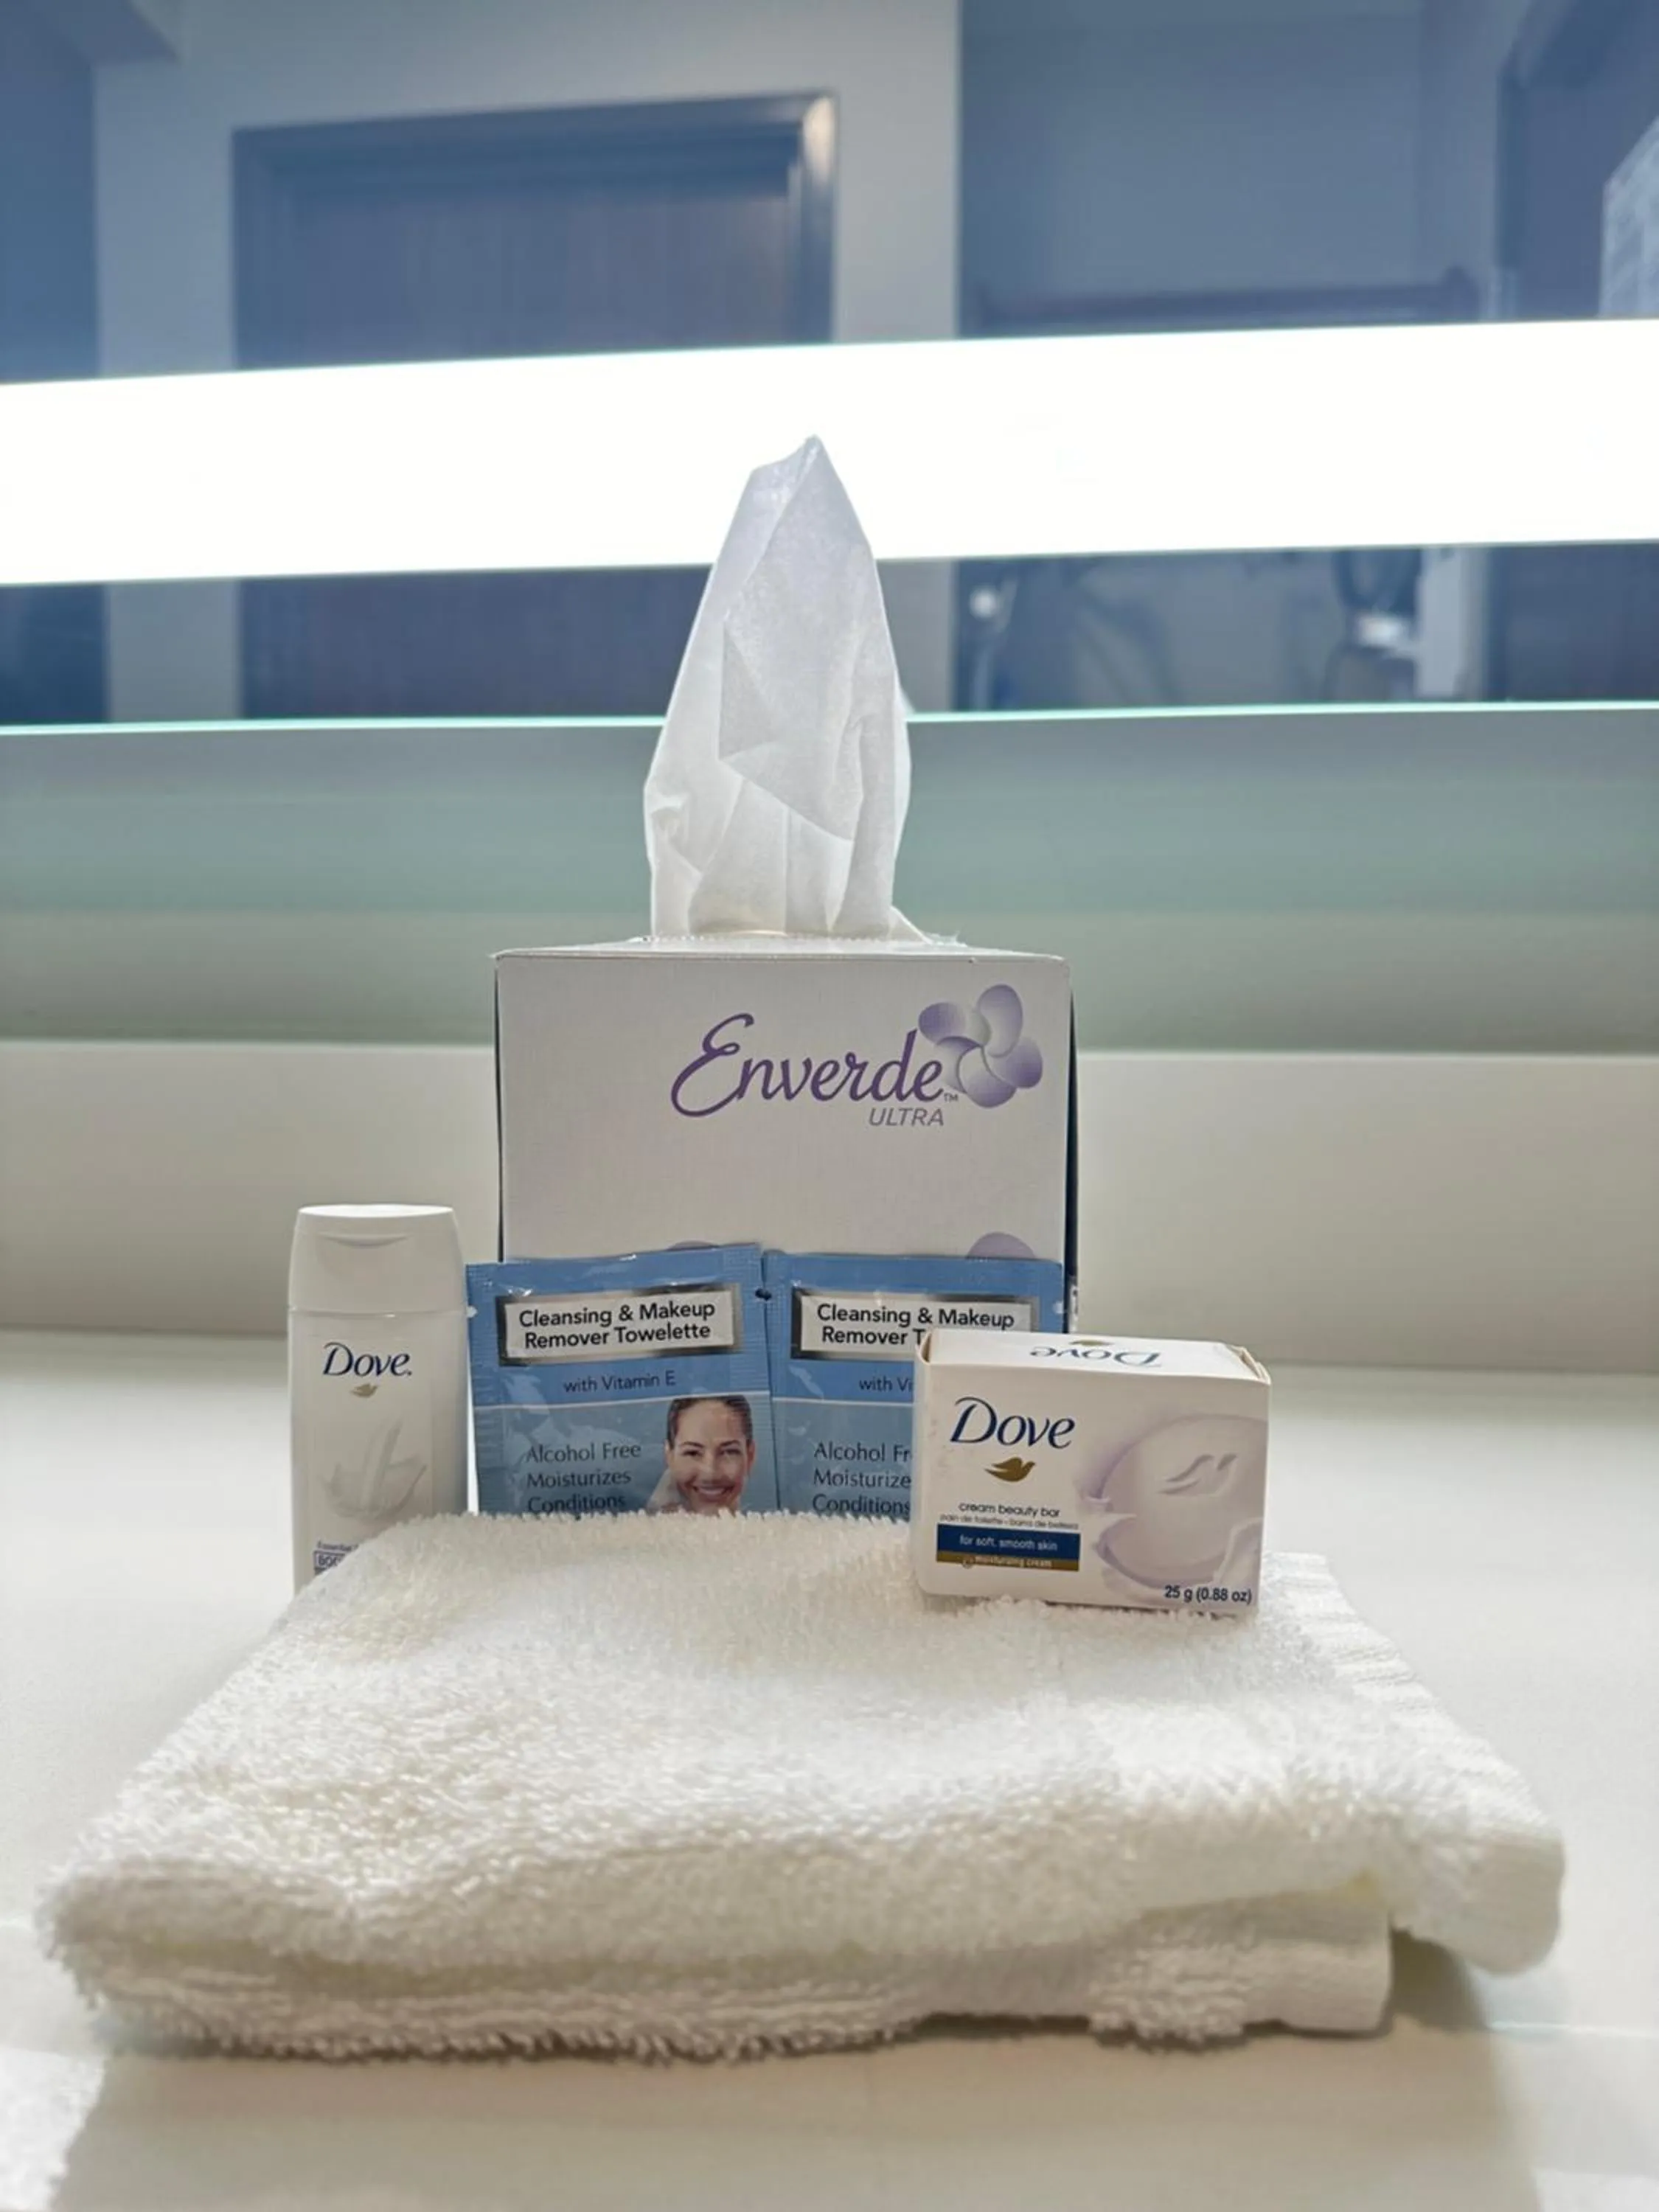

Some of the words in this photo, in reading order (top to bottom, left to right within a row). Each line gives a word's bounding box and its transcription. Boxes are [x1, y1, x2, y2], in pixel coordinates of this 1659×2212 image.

[671, 1013, 944, 1118] Enverde
[869, 1107, 945, 1127] ULTRA
[519, 1306, 612, 1327] Cleansing
[618, 1305, 633, 1321] &
[639, 1301, 715, 1321] Makeup
[817, 1304, 911, 1327] Cleansing
[917, 1307, 933, 1324] &
[939, 1308, 1015, 1330] Makeup
[524, 1329, 609, 1349] Remover
[614, 1323, 712, 1344] Towelette
[821, 1327, 908, 1346] Remover
[323, 1341, 412, 1377] Dove
[1029, 1346, 1161, 1367] Dove
[563, 1377, 598, 1393] with
[602, 1374, 660, 1391] Vitamin
[665, 1371, 676, 1386] E
[859, 1376, 893, 1391] with
[950, 1397, 1075, 1448] Dove
[526, 1442, 595, 1464] Alcohol
[602, 1441, 641, 1460] Free
[813, 1441, 886, 1462] Alcohol
[893, 1444, 912, 1462] Fr
[526, 1468, 632, 1488] Moisturizes
[813, 1467, 912, 1489] Moisturize
[527, 1493, 627, 1513] Conditions
[958, 1502, 995, 1513] cream
[998, 1503, 1038, 1518] beauty
[1040, 1507, 1060, 1517] bar
[959, 1534, 973, 1545] for
[999, 1538, 1035, 1549] smooth
[1037, 1540, 1058, 1551] skin
[1164, 1585, 1180, 1599] 25
[1183, 1588, 1193, 1604] g
[1196, 1586, 1228, 1604] (0.88
[1231, 1588, 1253, 1606] oz)
